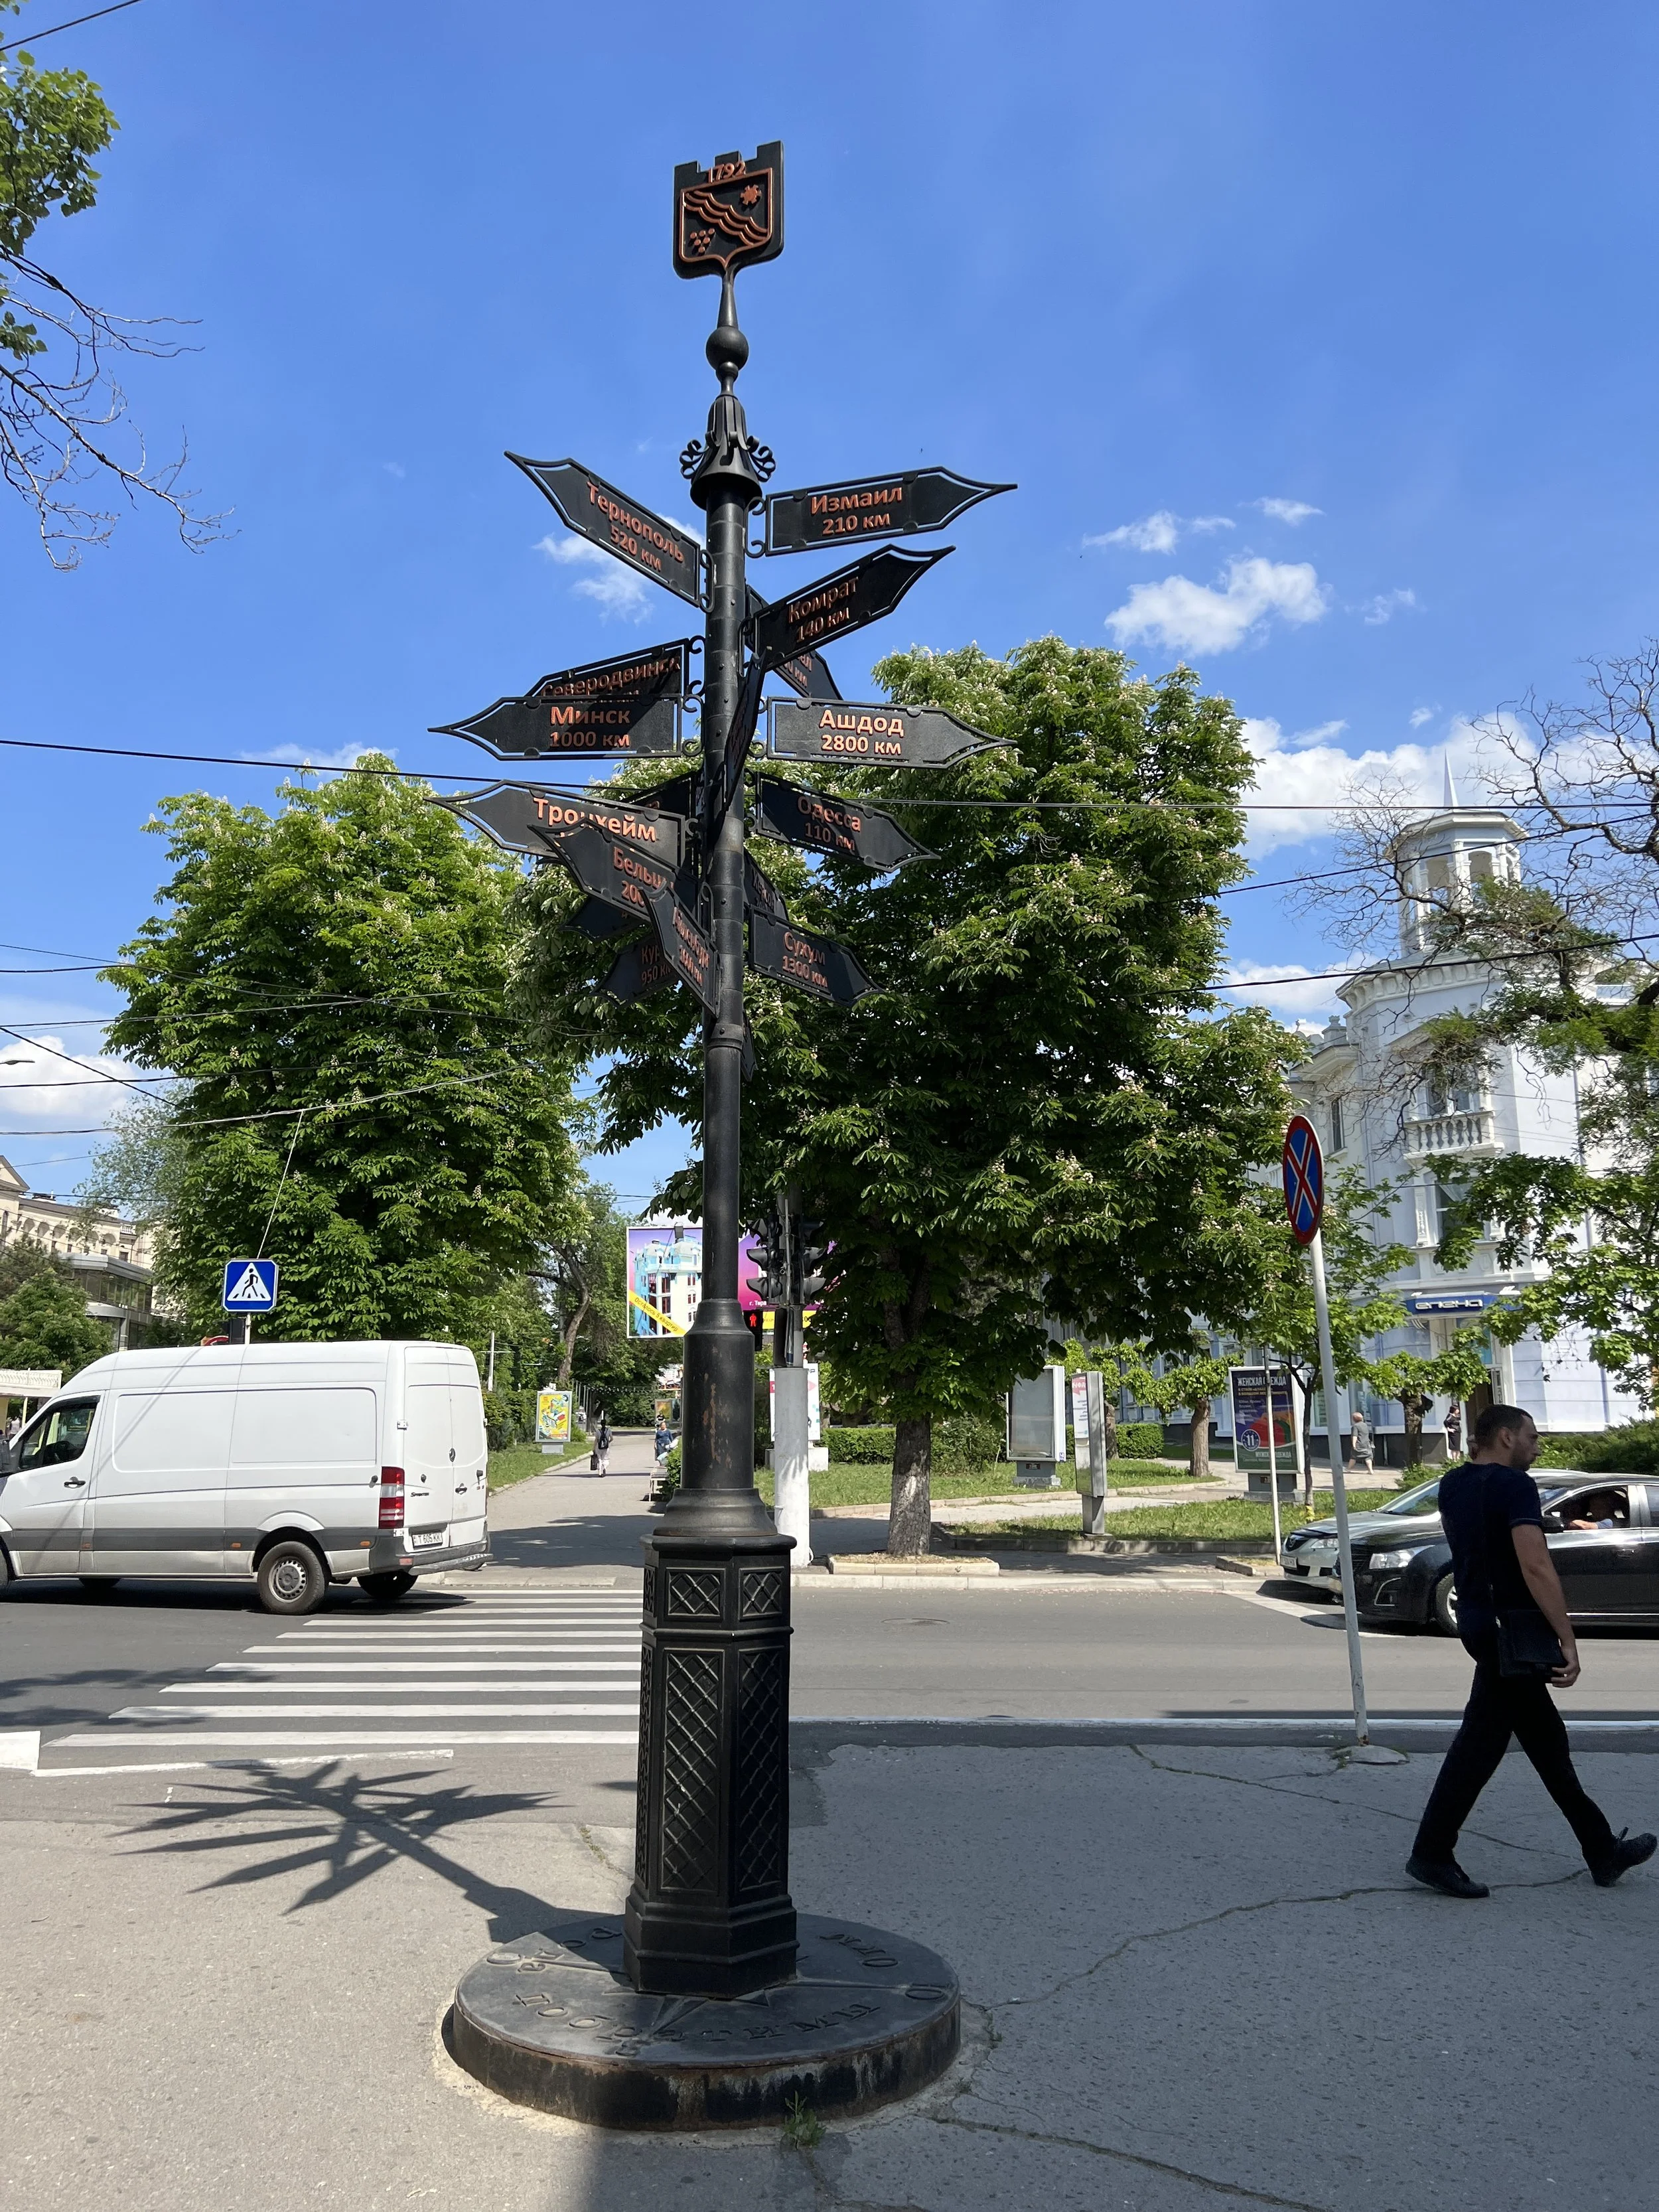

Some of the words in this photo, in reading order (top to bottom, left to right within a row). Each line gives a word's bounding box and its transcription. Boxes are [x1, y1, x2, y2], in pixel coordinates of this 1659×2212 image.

[708, 161, 746, 183] 1792
[811, 486, 902, 515] Измаил
[587, 481, 684, 562] Тернополь
[822, 515, 857, 535] 210
[863, 513, 891, 529] км
[611, 525, 637, 556] 520
[641, 548, 662, 571] км
[788, 576, 859, 624] Комрат
[796, 617, 824, 643] 140
[828, 607, 850, 627] км
[541, 655, 681, 697] Северодвинск
[551, 705, 630, 725] Минск
[820, 709, 904, 737] Ашдод
[549, 731, 597, 747] 1000
[603, 733, 630, 747] км
[821, 734, 868, 753] 2800
[875, 741, 902, 755] км
[798, 796, 861, 832] Одесса
[805, 822, 831, 843] 110
[835, 835, 855, 851] км
[783, 931, 826, 966] Сухум
[782, 955, 810, 980] 1300
[812, 970, 828, 988] км
[1237, 1376, 1263, 1386] ЖЕНСКАЯ
[1263, 1376, 1287, 1386] ОЕЖДА
[1246, 1434, 1255, 1446] 11
